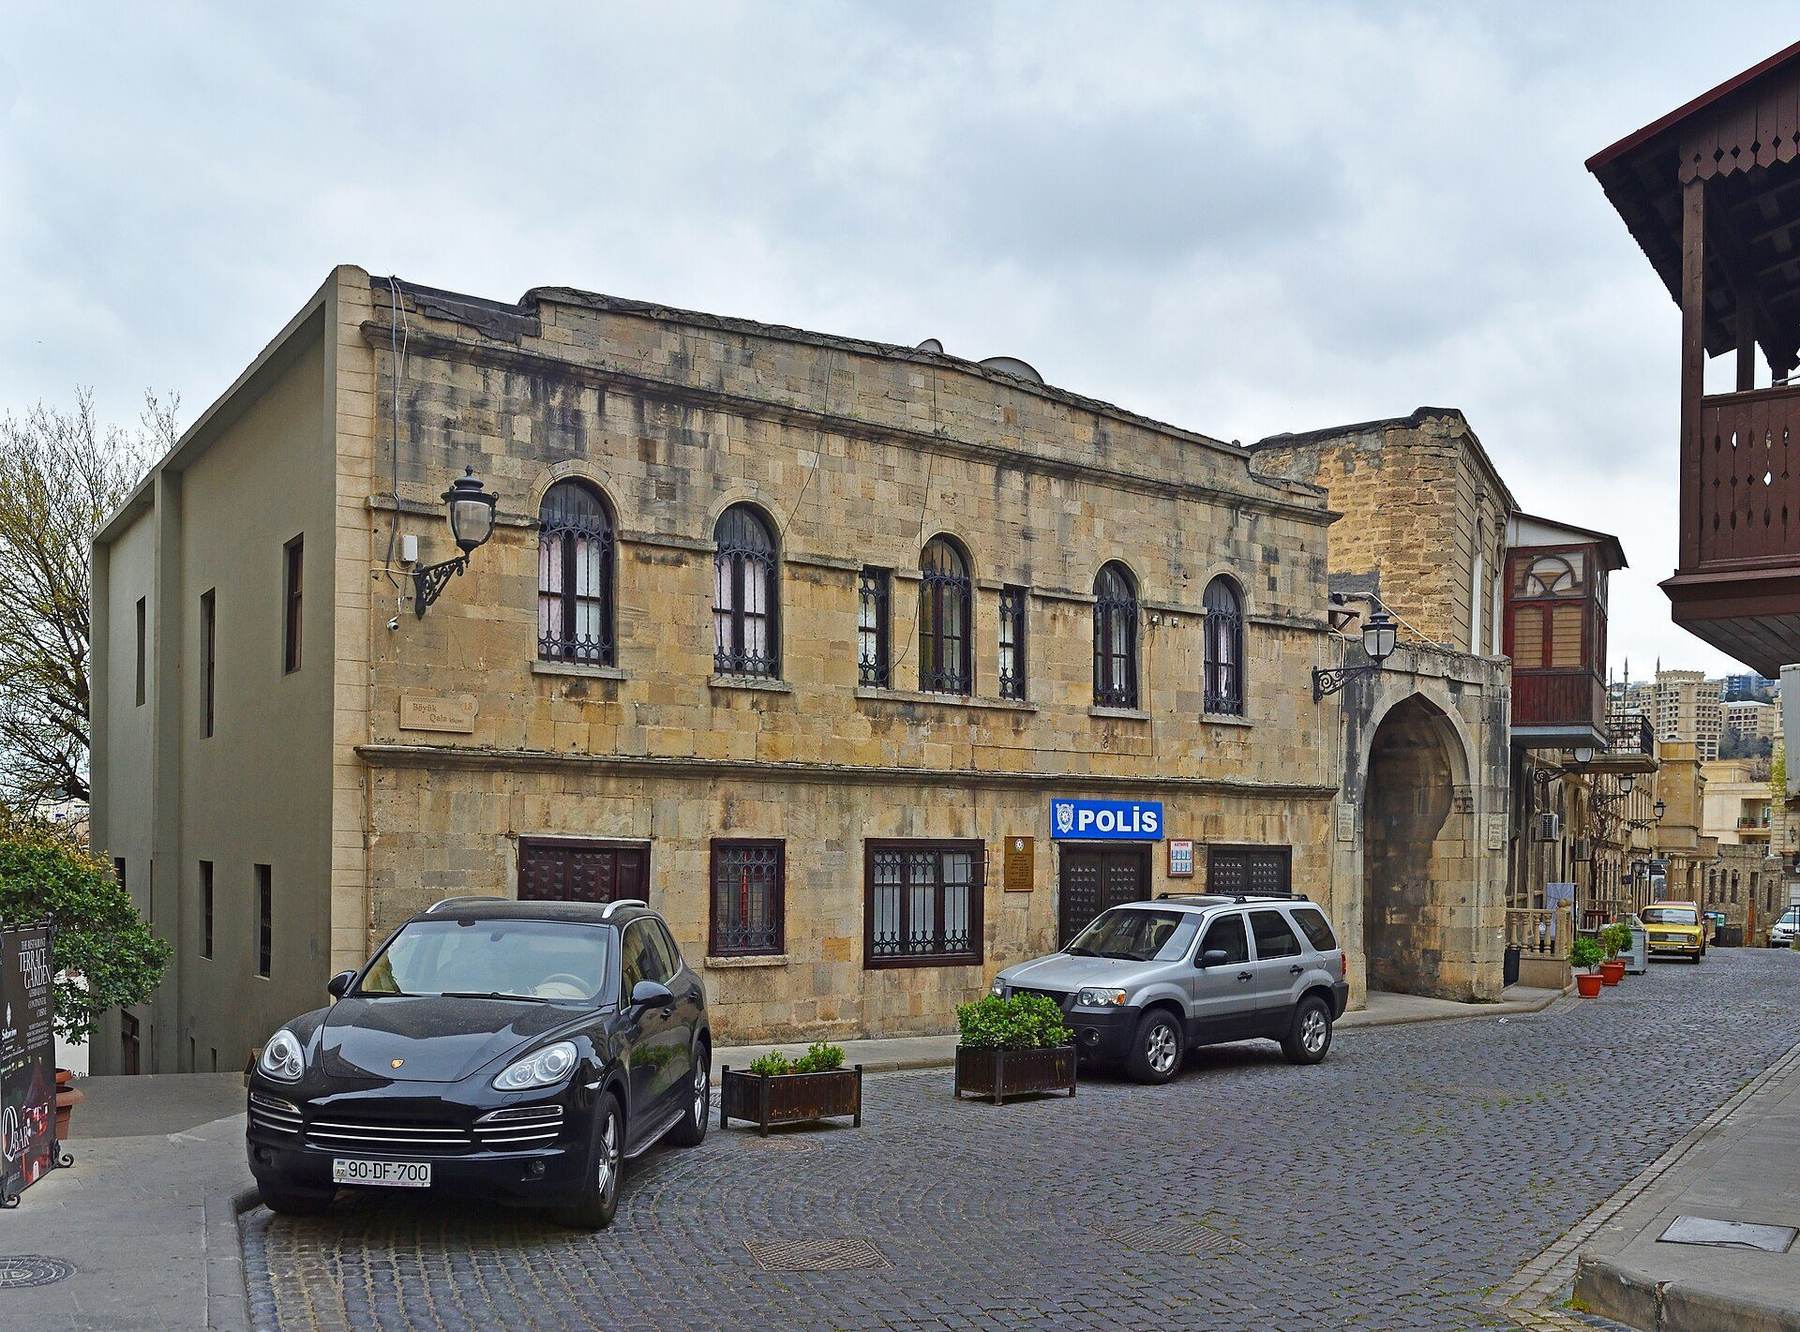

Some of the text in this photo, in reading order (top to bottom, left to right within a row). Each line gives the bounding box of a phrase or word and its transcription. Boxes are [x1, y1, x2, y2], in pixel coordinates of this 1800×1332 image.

[1078, 805, 1158, 833] POLİS
[18, 947, 47, 973] TERRACE
[24, 964, 52, 990] GARDEN
[348, 1161, 428, 1181] 90-DF-700
